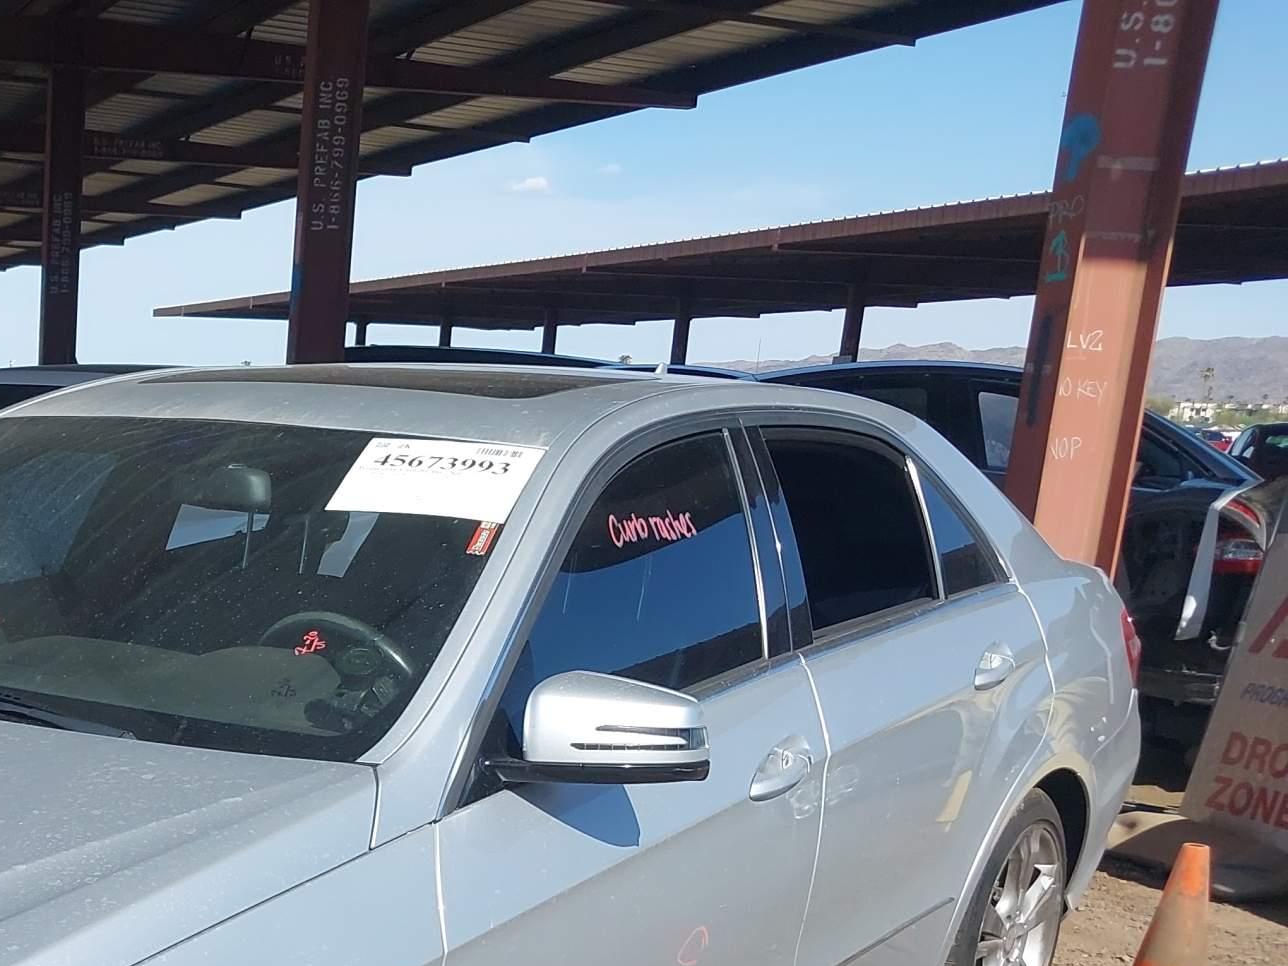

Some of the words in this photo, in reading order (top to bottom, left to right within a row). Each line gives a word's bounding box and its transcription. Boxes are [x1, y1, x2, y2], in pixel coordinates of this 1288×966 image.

[319, 80, 333, 109] INC
[314, 119, 331, 187] PREFAB
[374, 453, 511, 475] 45673993
[648, 509, 697, 541] rashes
